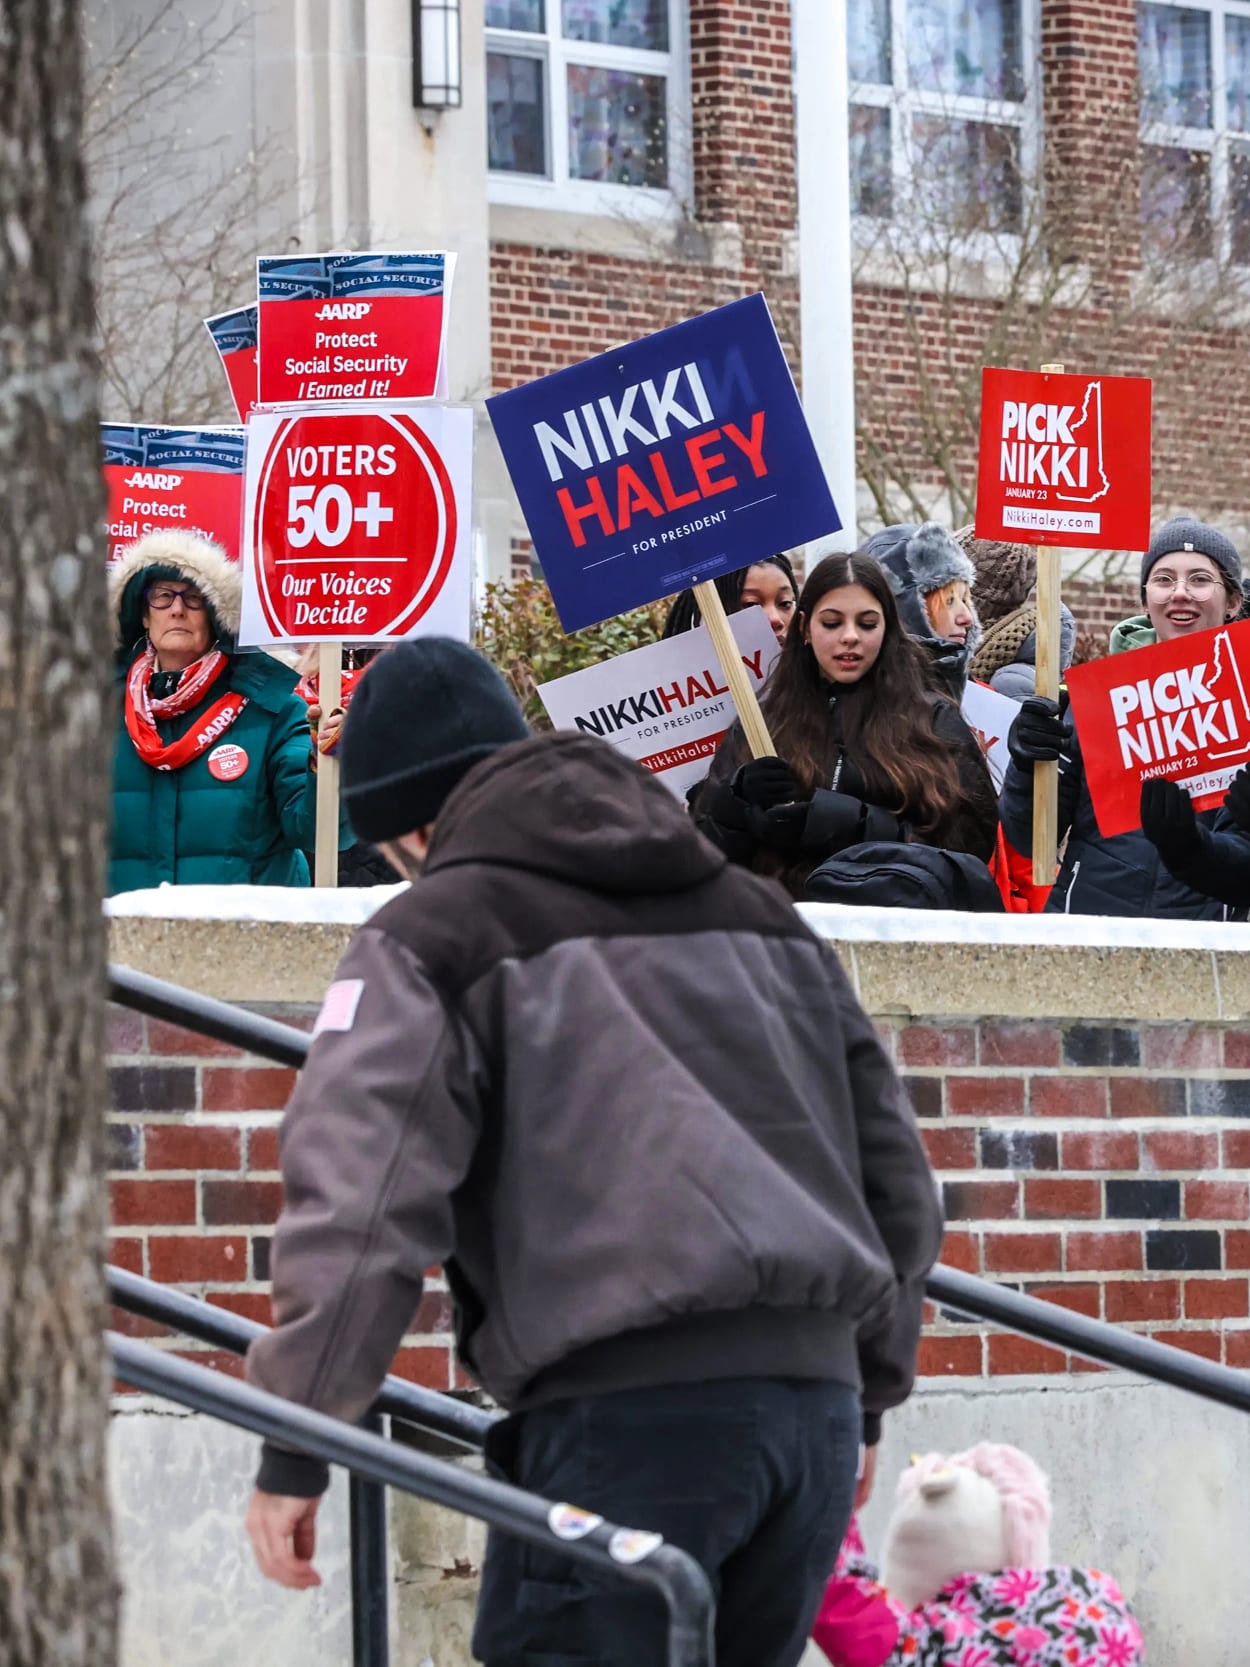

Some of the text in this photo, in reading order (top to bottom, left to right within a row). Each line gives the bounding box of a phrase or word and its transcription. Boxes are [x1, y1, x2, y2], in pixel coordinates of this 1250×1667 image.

[335, 274, 381, 291] SOCIAL
[315, 302, 371, 321] AARP
[315, 332, 377, 349] Protect
[285, 354, 408, 376] Social Security
[298, 379, 391, 399] I Earned It!
[533, 362, 715, 482] NIKKI
[1002, 401, 1076, 444] PICK
[148, 451, 193, 461] SOCIAL
[287, 444, 397, 478] VOTERS
[1000, 441, 1088, 487] NIKKI
[124, 472, 182, 491] AARP
[556, 410, 768, 548] HALEY
[1005, 487, 1047, 500] JANUARY 23
[123, 498, 187, 518] Protect
[287, 483, 394, 548] 50+
[1007, 510, 1093, 529] NikkiHaley.com
[632, 510, 727, 554] FOR PRESIDENT
[281, 570, 392, 597] Our Voices
[294, 600, 368, 625] Decide
[574, 650, 763, 736] NIKKIHALY
[1109, 663, 1216, 727] PICK
[195, 706, 235, 751] AARP
[637, 702, 726, 739] FOR PRESIDENT
[1117, 699, 1239, 769] NIKKI
[1139, 756, 1198, 781] JANUARY 23
